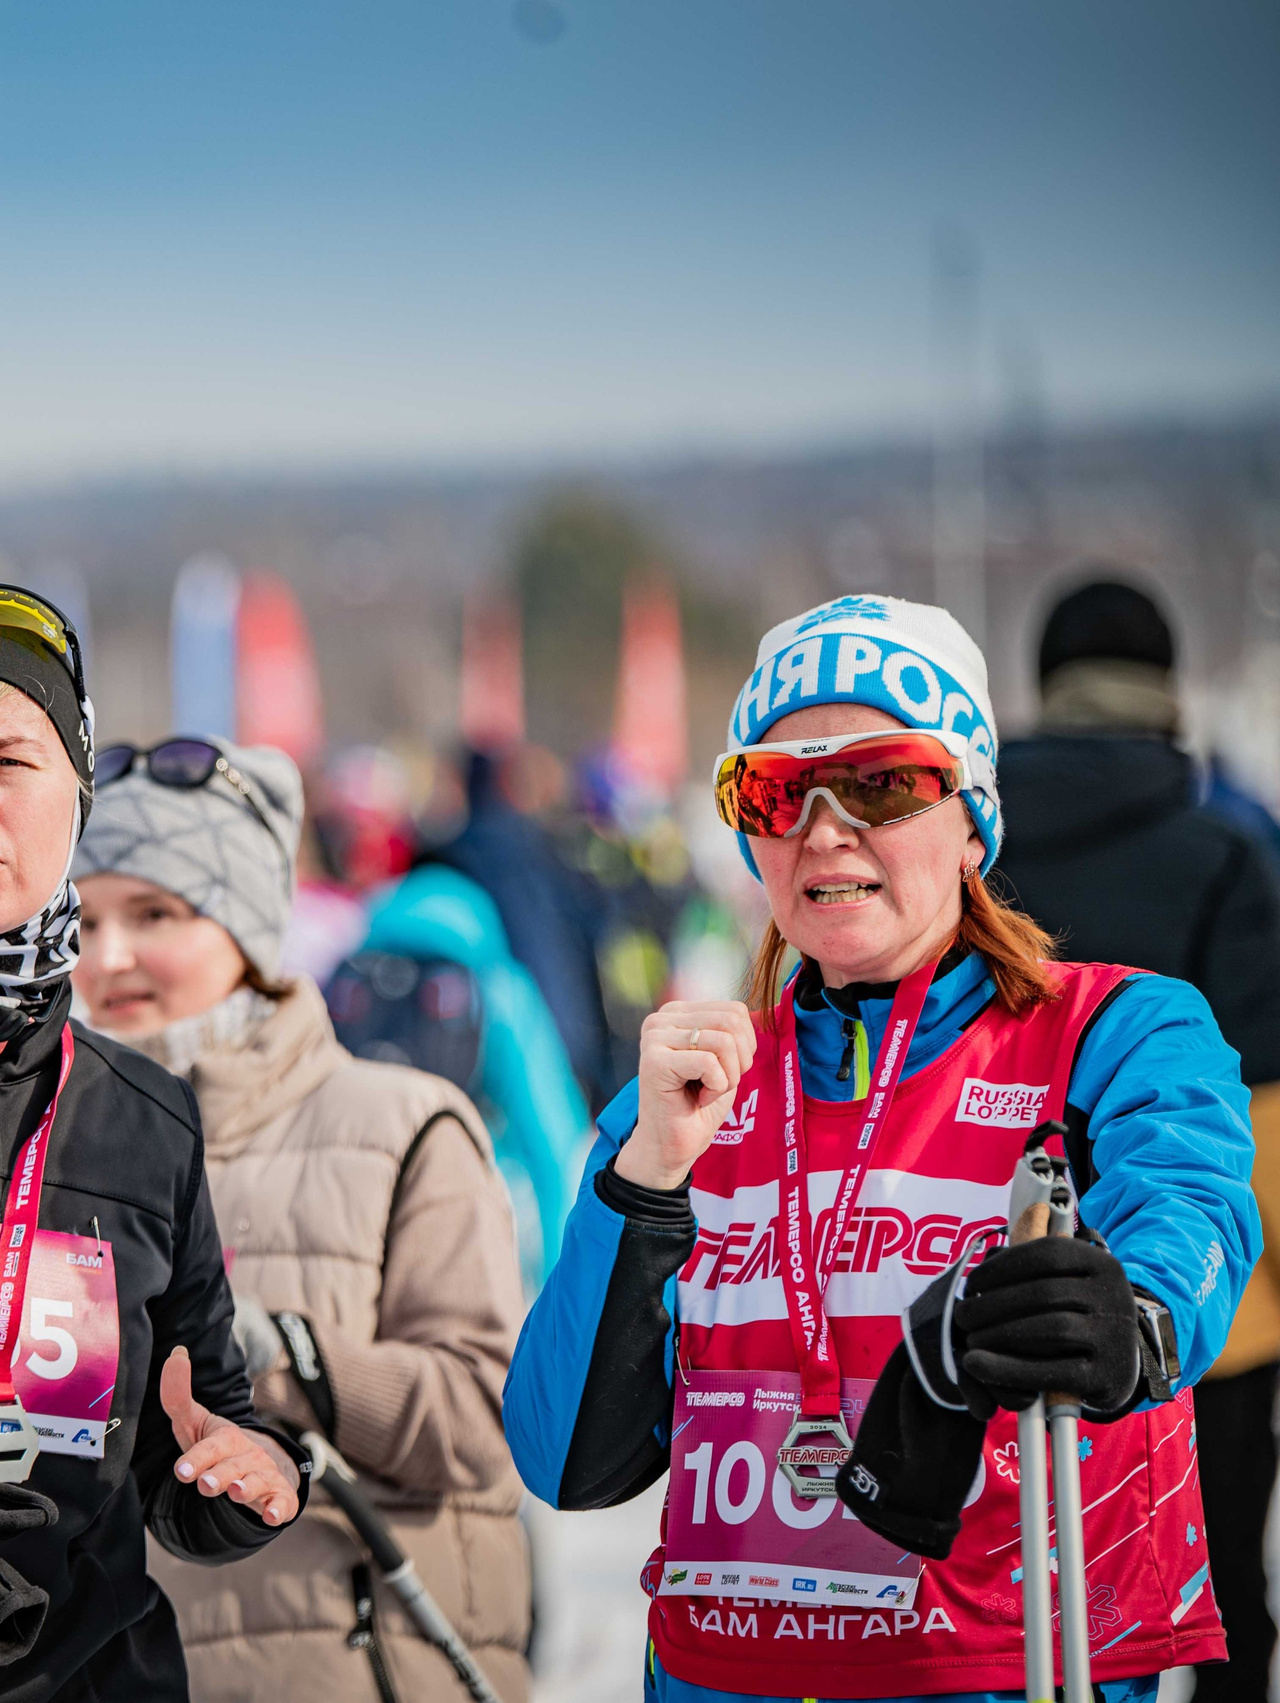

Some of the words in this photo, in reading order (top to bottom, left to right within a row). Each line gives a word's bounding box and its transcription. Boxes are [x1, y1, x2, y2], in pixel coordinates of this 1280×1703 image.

[801, 744, 828, 754] RELAX
[878, 1019, 908, 1087] ТЕМЕРСО
[785, 1051, 796, 1117] ТЕМЕРСО
[968, 1085, 1045, 1107] RUSSIA
[964, 1101, 1040, 1121] LOPPET
[826, 1164, 861, 1266] ТЕМЕРСО
[788, 1186, 805, 1283] ТЕМЕРСО
[66, 1252, 103, 1269] БАМ
[686, 1392, 746, 1407] ТЕМЕРСО
[753, 1388, 795, 1401] Лыжня
[752, 1399, 801, 1412] Иркутск
[780, 1448, 853, 1464] ТЕМЕРС
[684, 1440, 863, 1530] 100
[773, 1607, 957, 1640] АНГАРА
